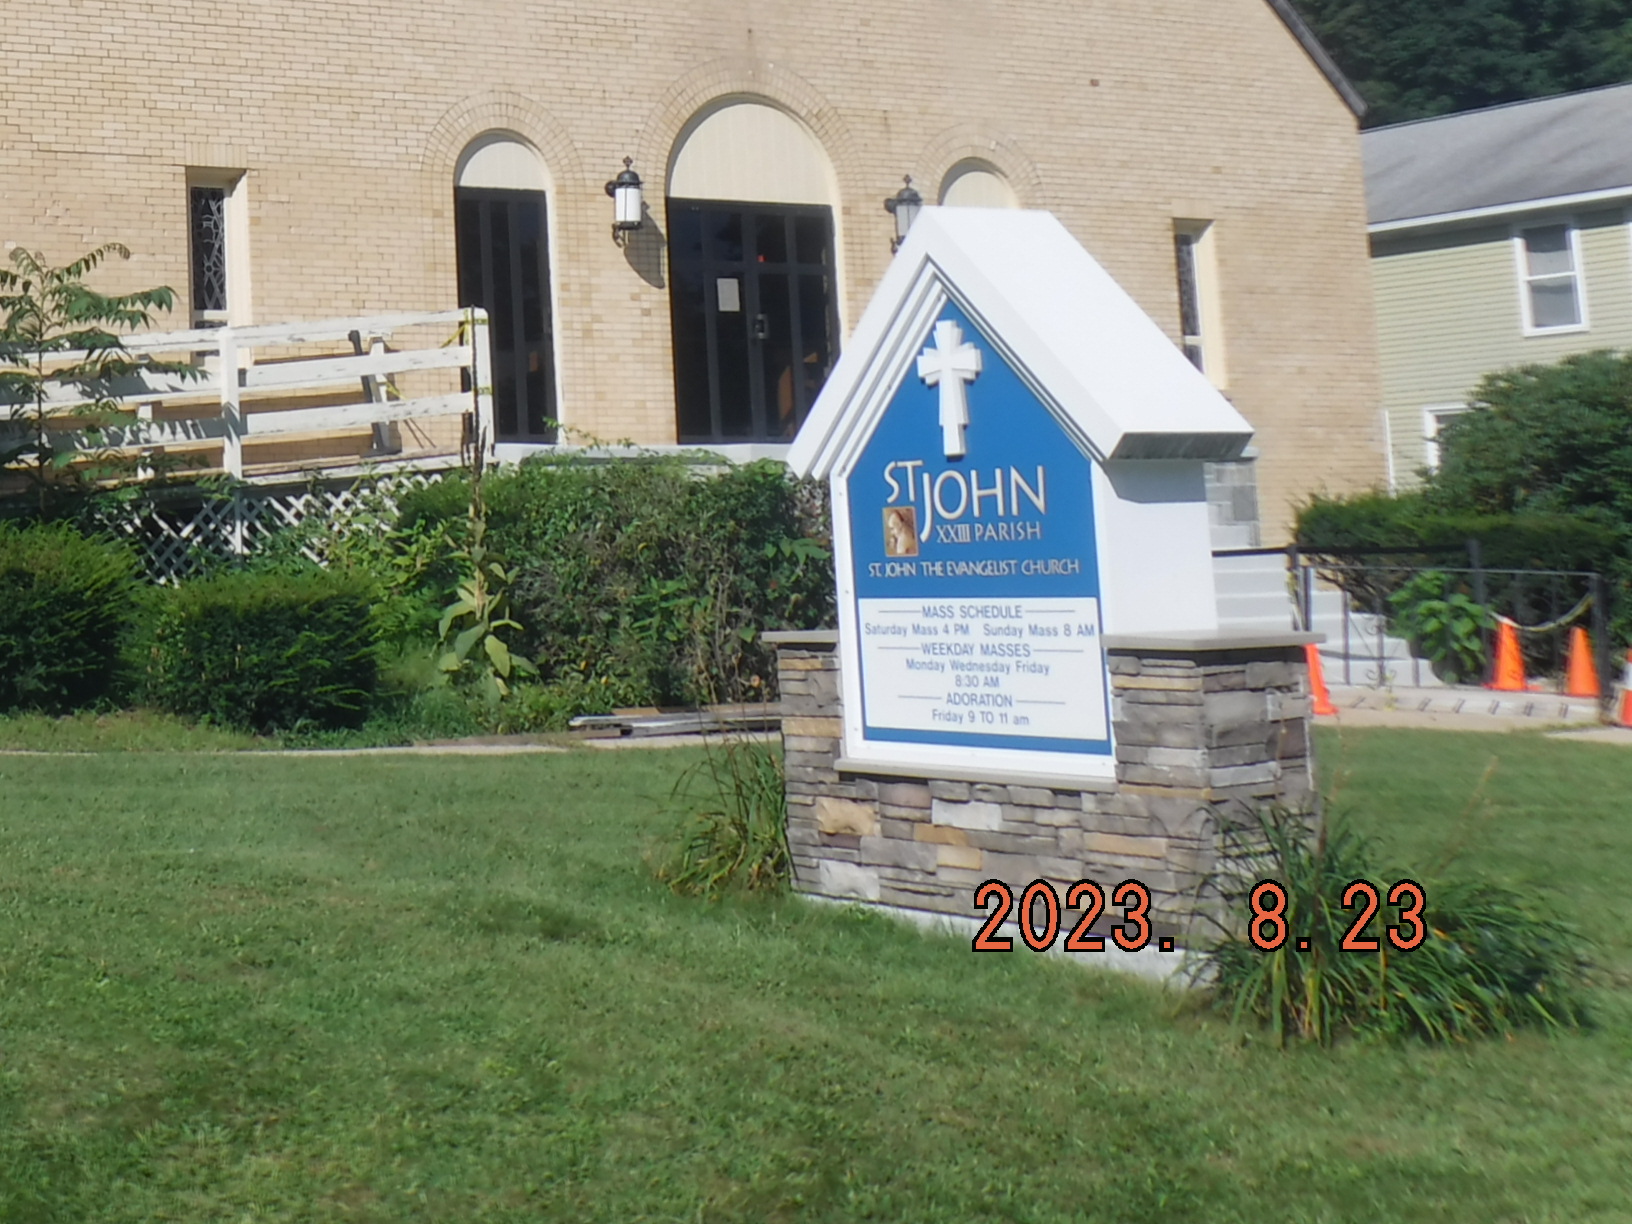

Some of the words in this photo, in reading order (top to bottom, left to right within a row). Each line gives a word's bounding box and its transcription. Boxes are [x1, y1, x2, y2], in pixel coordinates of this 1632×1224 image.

[883, 460, 924, 503] ST
[920, 465, 1046, 543] JOHN
[936, 524, 970, 542] XXIII
[975, 521, 1041, 541] PARISH
[885, 562, 916, 577] JOHN
[920, 561, 944, 576] THE
[946, 560, 1016, 576] EVANGELIST
[1021, 559, 1079, 575] CHURCH
[922, 605, 954, 618] MASS
[960, 605, 1022, 619] SCHEDULE
[865, 623, 907, 636] Saturday
[912, 624, 938, 636] Mass
[943, 624, 949, 635] 4
[954, 624, 969, 635] PM
[983, 624, 1024, 638] Sunday
[1029, 624, 1058, 636] Mass
[1064, 624, 1071, 636] 8
[1077, 624, 1094, 636] AM
[921, 643, 974, 655] WEEKDAY
[980, 644, 1030, 657] MASSES
[906, 659, 945, 672] Monday
[950, 660, 1010, 674] Wednesday
[1016, 661, 1049, 676] Friday
[955, 675, 979, 687] 8:30
[983, 676, 999, 687] AM
[946, 693, 1012, 707] ADORATION
[932, 709, 963, 724] Friday
[968, 711, 975, 723] 9
[980, 711, 994, 723] TO
[1000, 713, 1008, 723] 11
[1013, 716, 1029, 725] am
